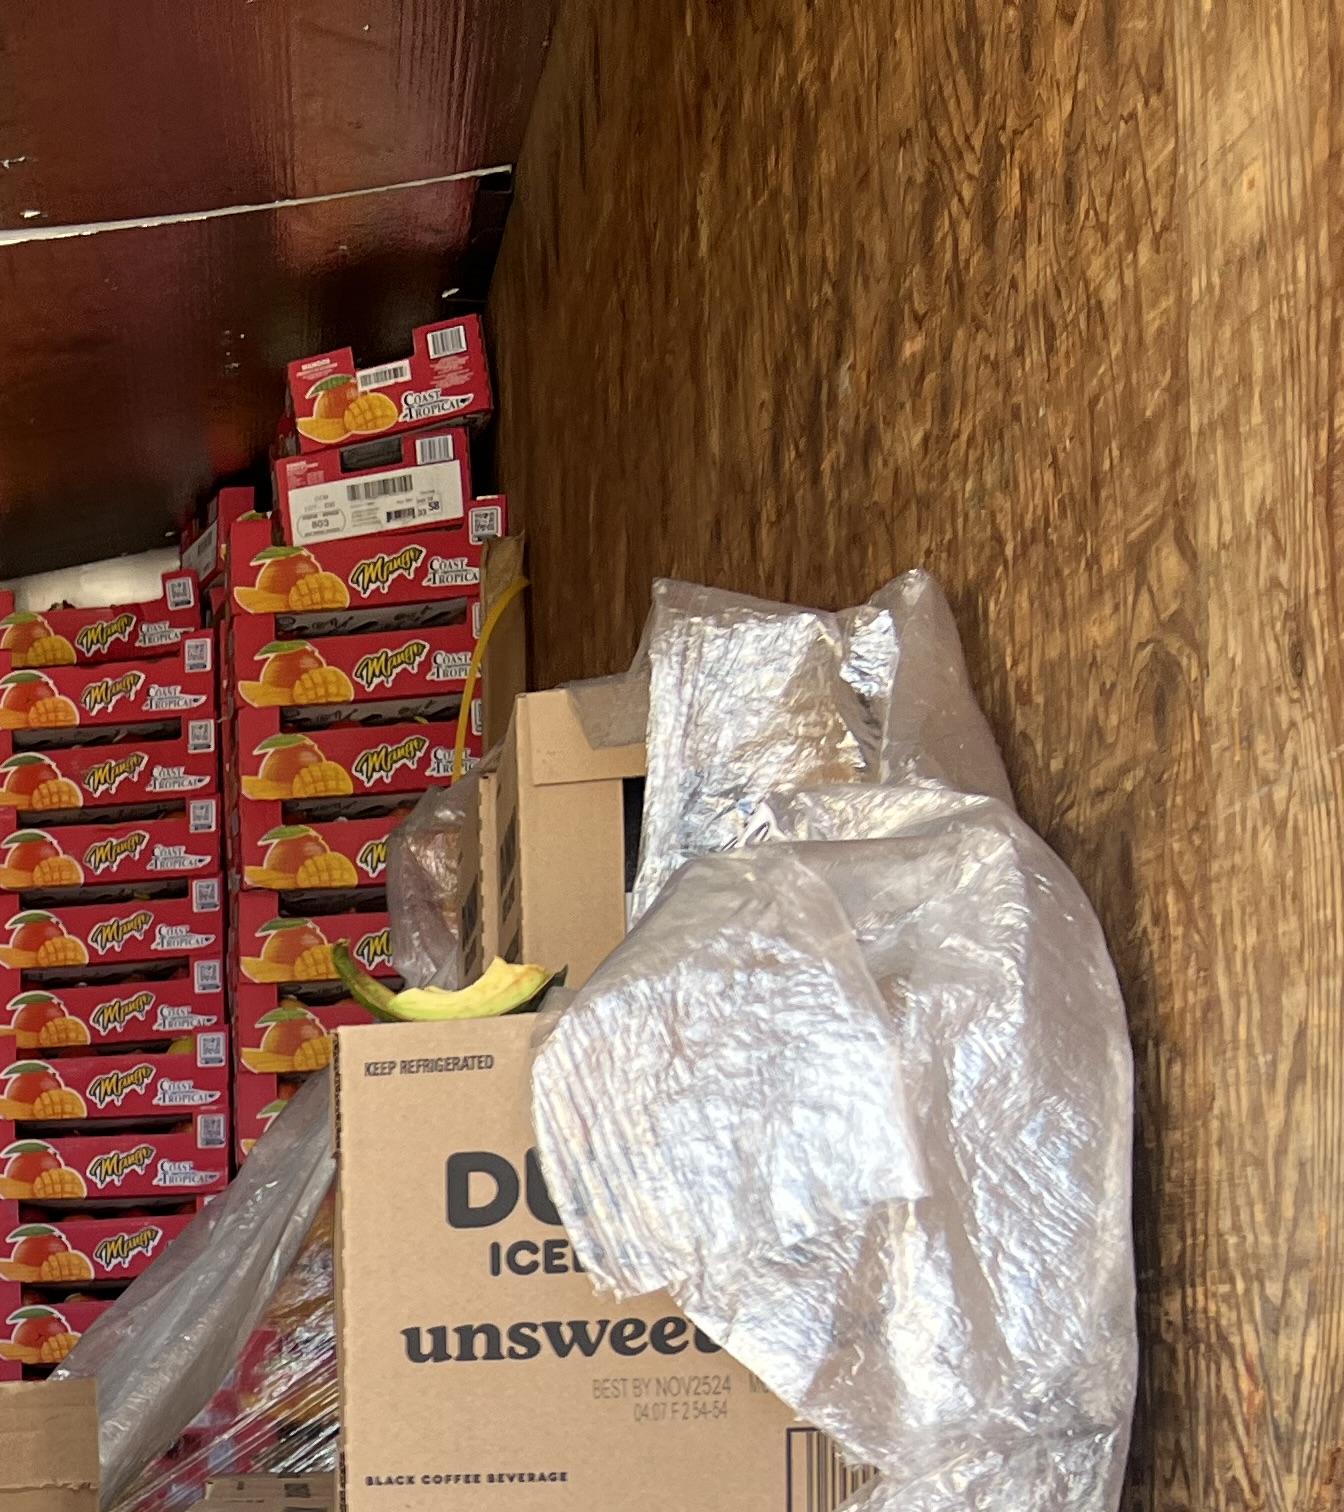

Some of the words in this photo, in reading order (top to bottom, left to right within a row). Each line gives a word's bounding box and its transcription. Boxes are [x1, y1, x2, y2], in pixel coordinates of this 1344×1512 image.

[404, 389, 440, 407] COAST
[351, 547, 423, 596] Mango
[427, 569, 479, 585] TROPICA
[430, 557, 467, 571] COAST
[355, 641, 427, 690] Mango
[430, 663, 472, 680] TROPI
[354, 737, 428, 785] Mango
[364, 1060, 397, 1077] KEEP
[399, 1055, 495, 1074] REFRIGERATED
[87, 1064, 155, 1108] Mango
[87, 1145, 155, 1188] Mango
[94, 1227, 162, 1271] Mango
[489, 1239, 590, 1277] ICE
[400, 1316, 723, 1363] unswee
[592, 1378, 628, 1399] BEST
[633, 1377, 652, 1398] BY
[655, 1375, 731, 1397] NOV2524
[365, 1475, 415, 1486] BLACK
[421, 1474, 481, 1485] COFFEE
[486, 1471, 568, 1483] BEVERAGE
